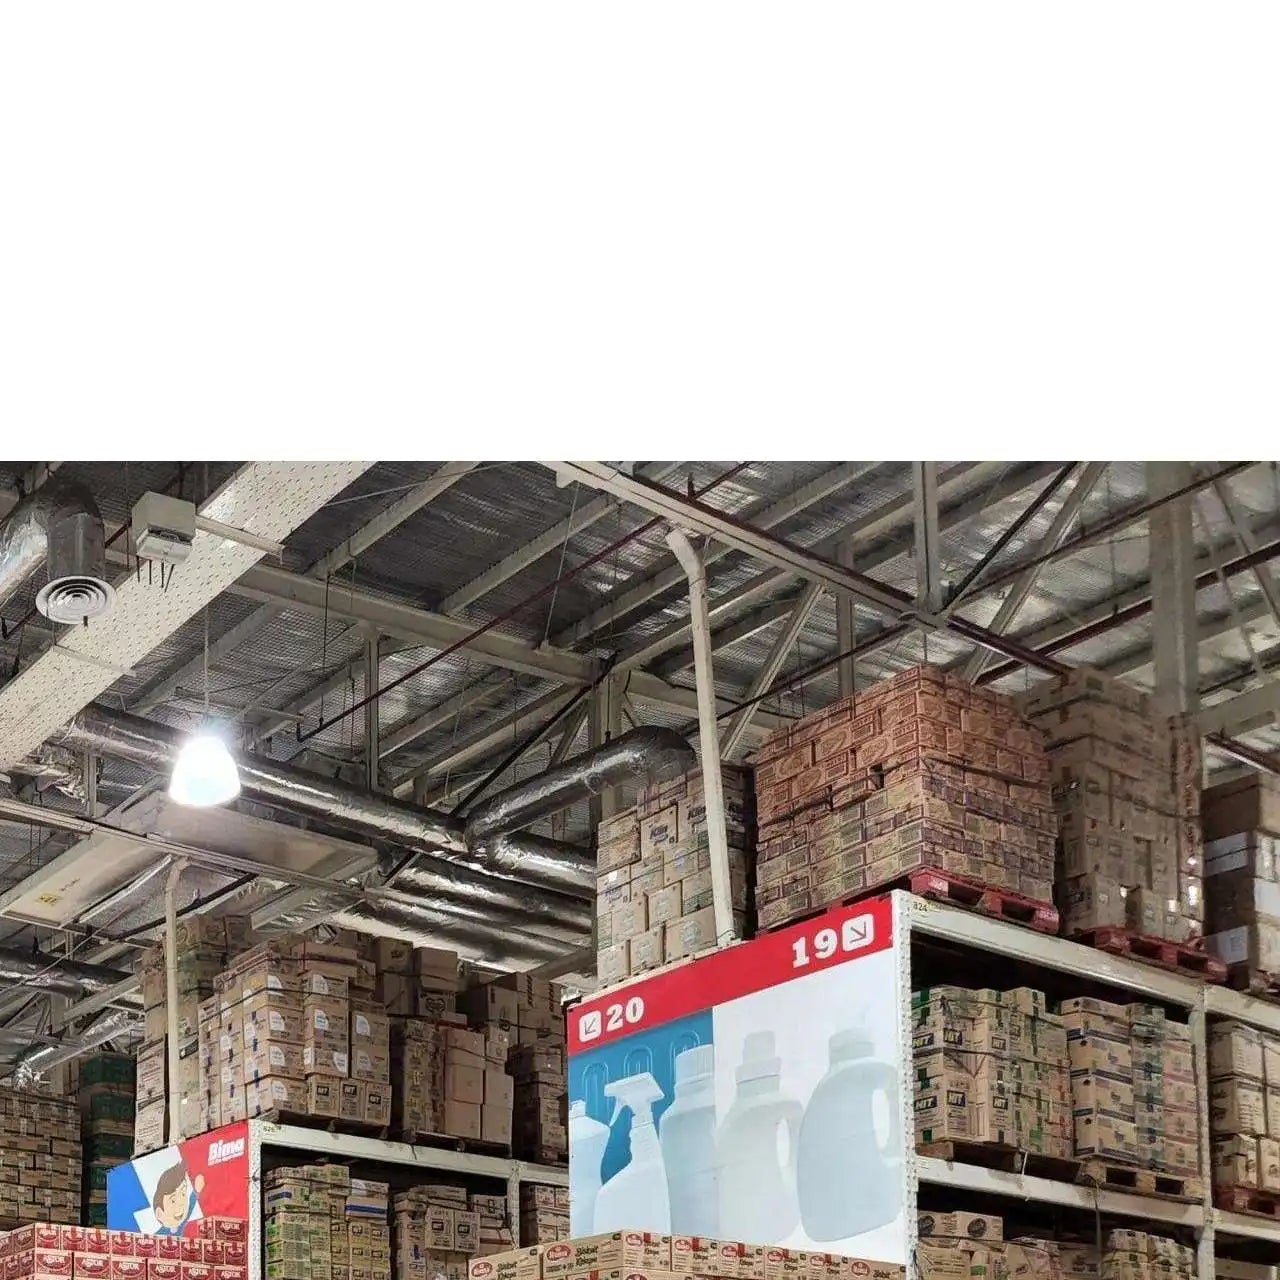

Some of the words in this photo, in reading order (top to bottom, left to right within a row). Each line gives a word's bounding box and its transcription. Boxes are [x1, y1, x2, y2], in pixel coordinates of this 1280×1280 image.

[792, 929, 838, 968] 19
[606, 997, 645, 1032] 20
[220, 1222, 240, 1230] ASTOR
[43, 1254, 64, 1263] ASTOR
[82, 1257, 103, 1267] ASTOR
[119, 1261, 139, 1270] ASTOR
[221, 1270, 240, 1279] ASTOR
